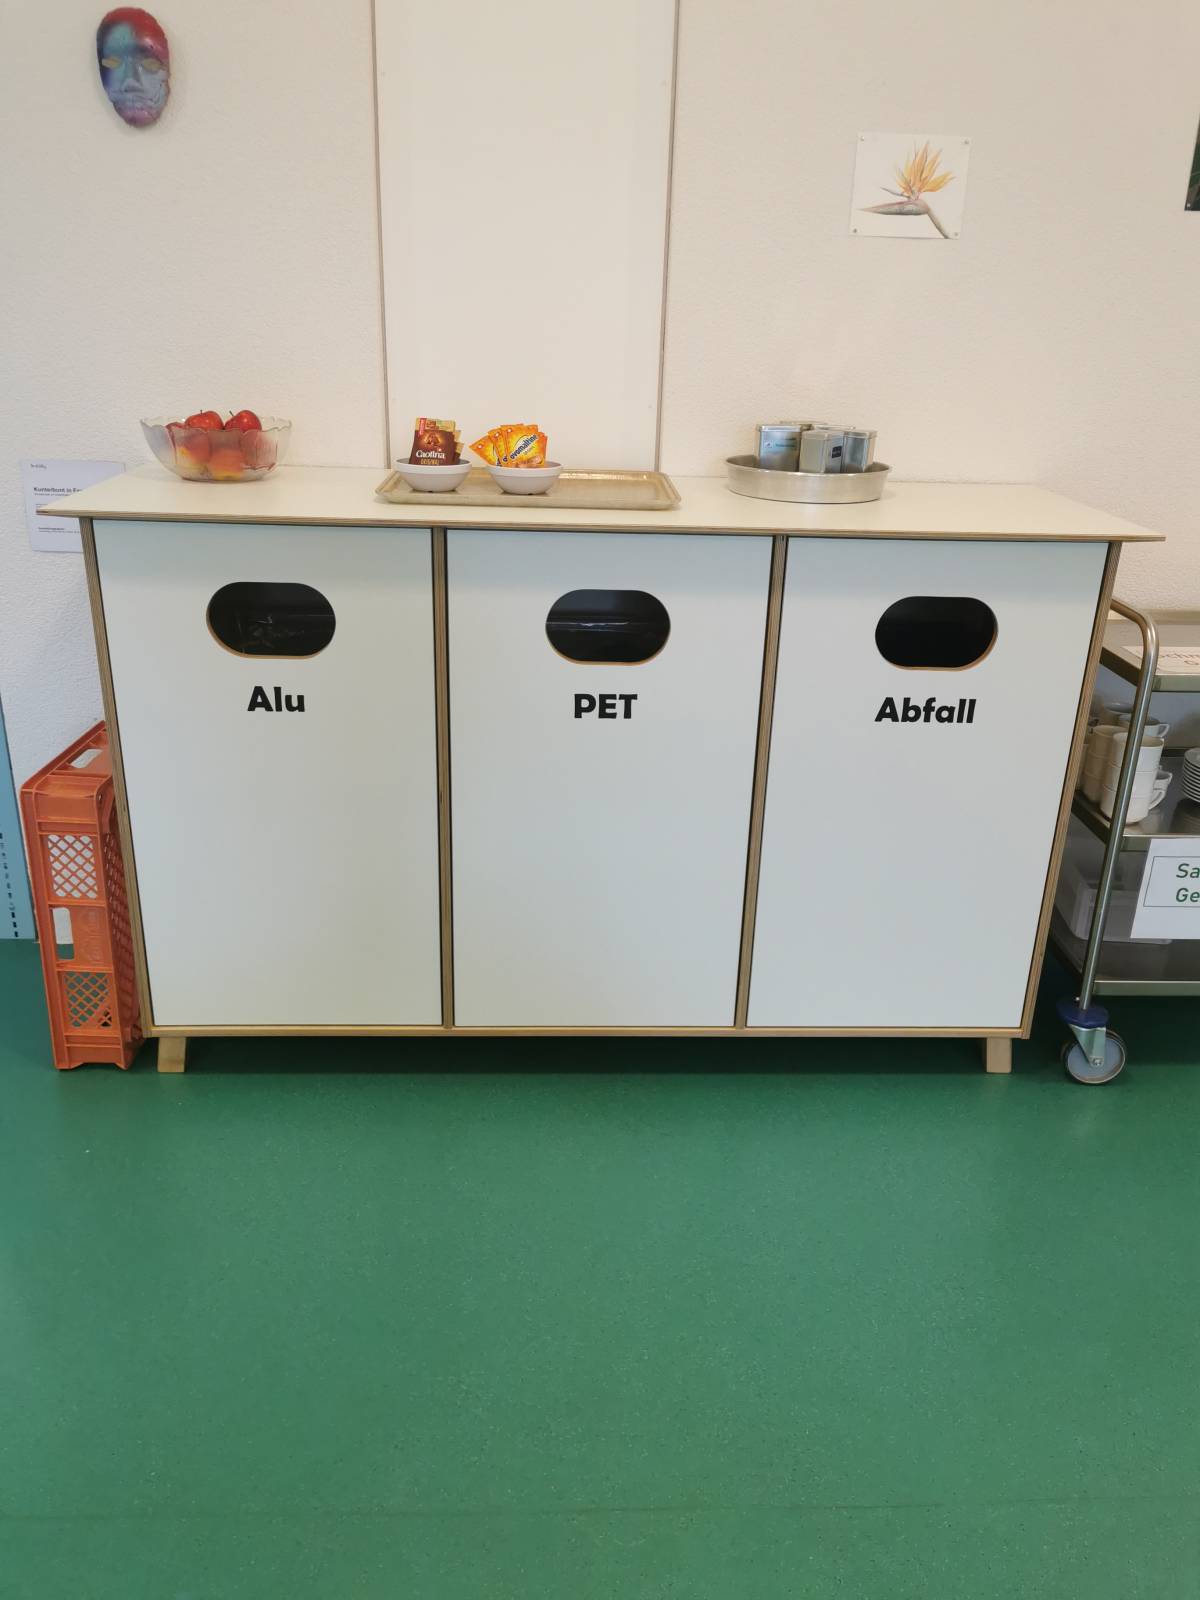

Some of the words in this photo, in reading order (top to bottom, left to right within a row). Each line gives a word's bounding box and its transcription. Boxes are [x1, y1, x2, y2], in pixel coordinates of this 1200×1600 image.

[415, 448, 446, 460] Caotina
[247, 685, 306, 713] Alu
[574, 693, 638, 720] PET
[874, 696, 977, 724] Abfall
[1176, 862, 1200, 879] Sa
[1175, 887, 1200, 903] Ge
